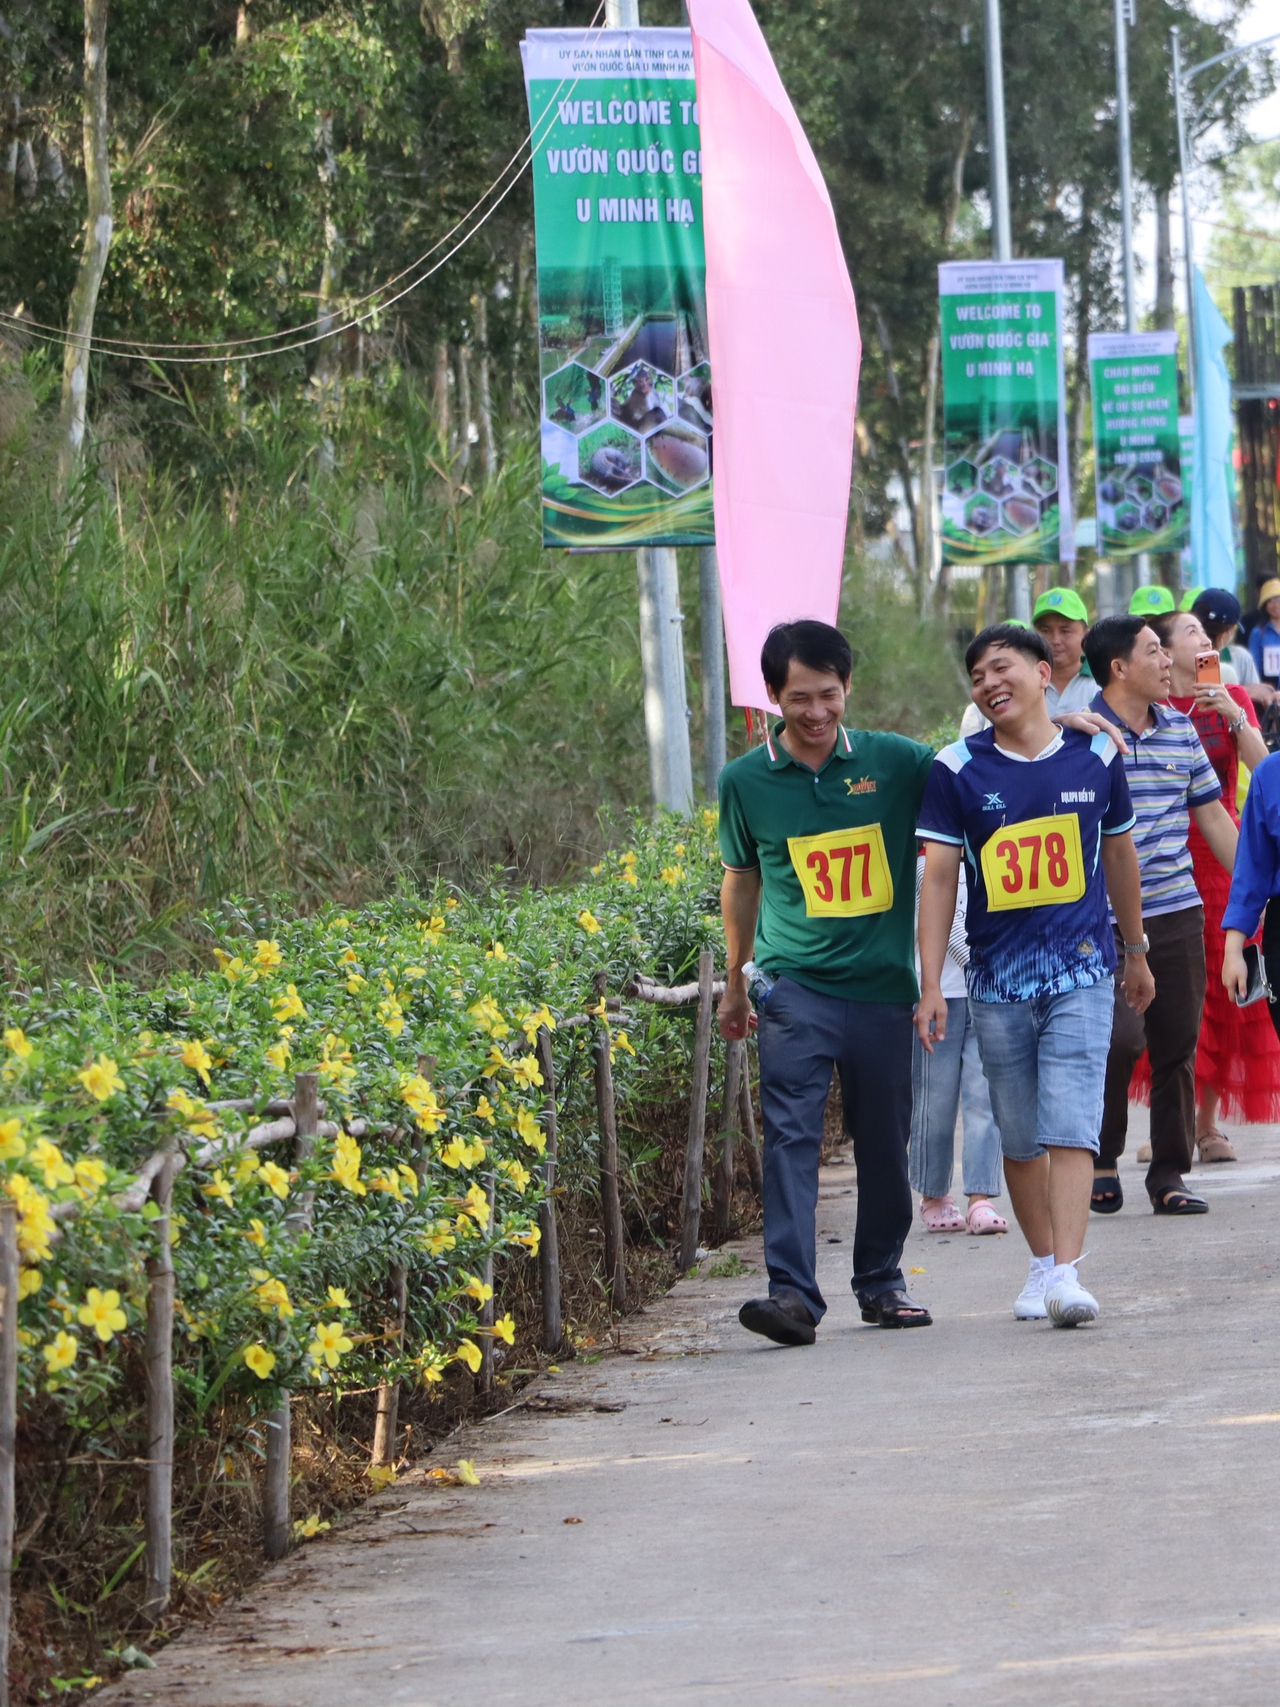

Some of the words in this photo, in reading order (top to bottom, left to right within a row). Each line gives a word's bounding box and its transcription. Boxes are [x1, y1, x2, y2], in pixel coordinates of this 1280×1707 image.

[626, 62, 640, 72] GIA
[643, 62, 649, 72] U
[651, 62, 675, 72] MINH
[557, 100, 672, 126] WELCOME
[546, 143, 609, 175] VƯỜN
[616, 141, 675, 176] QUỐC
[576, 198, 591, 223] U
[598, 198, 659, 223] MINH
[665, 198, 695, 228] HẠ
[956, 304, 1021, 321] WELCOME
[1025, 303, 1042, 319] TO
[949, 331, 985, 350] VƯỜN
[987, 328, 1023, 349] QUỐC
[1026, 332, 1050, 348] GIA
[966, 362, 975, 378] U
[978, 361, 1012, 377] MINH
[1016, 361, 1034, 379] HẠ
[806, 843, 872, 902] 377
[996, 832, 1069, 893] 378
